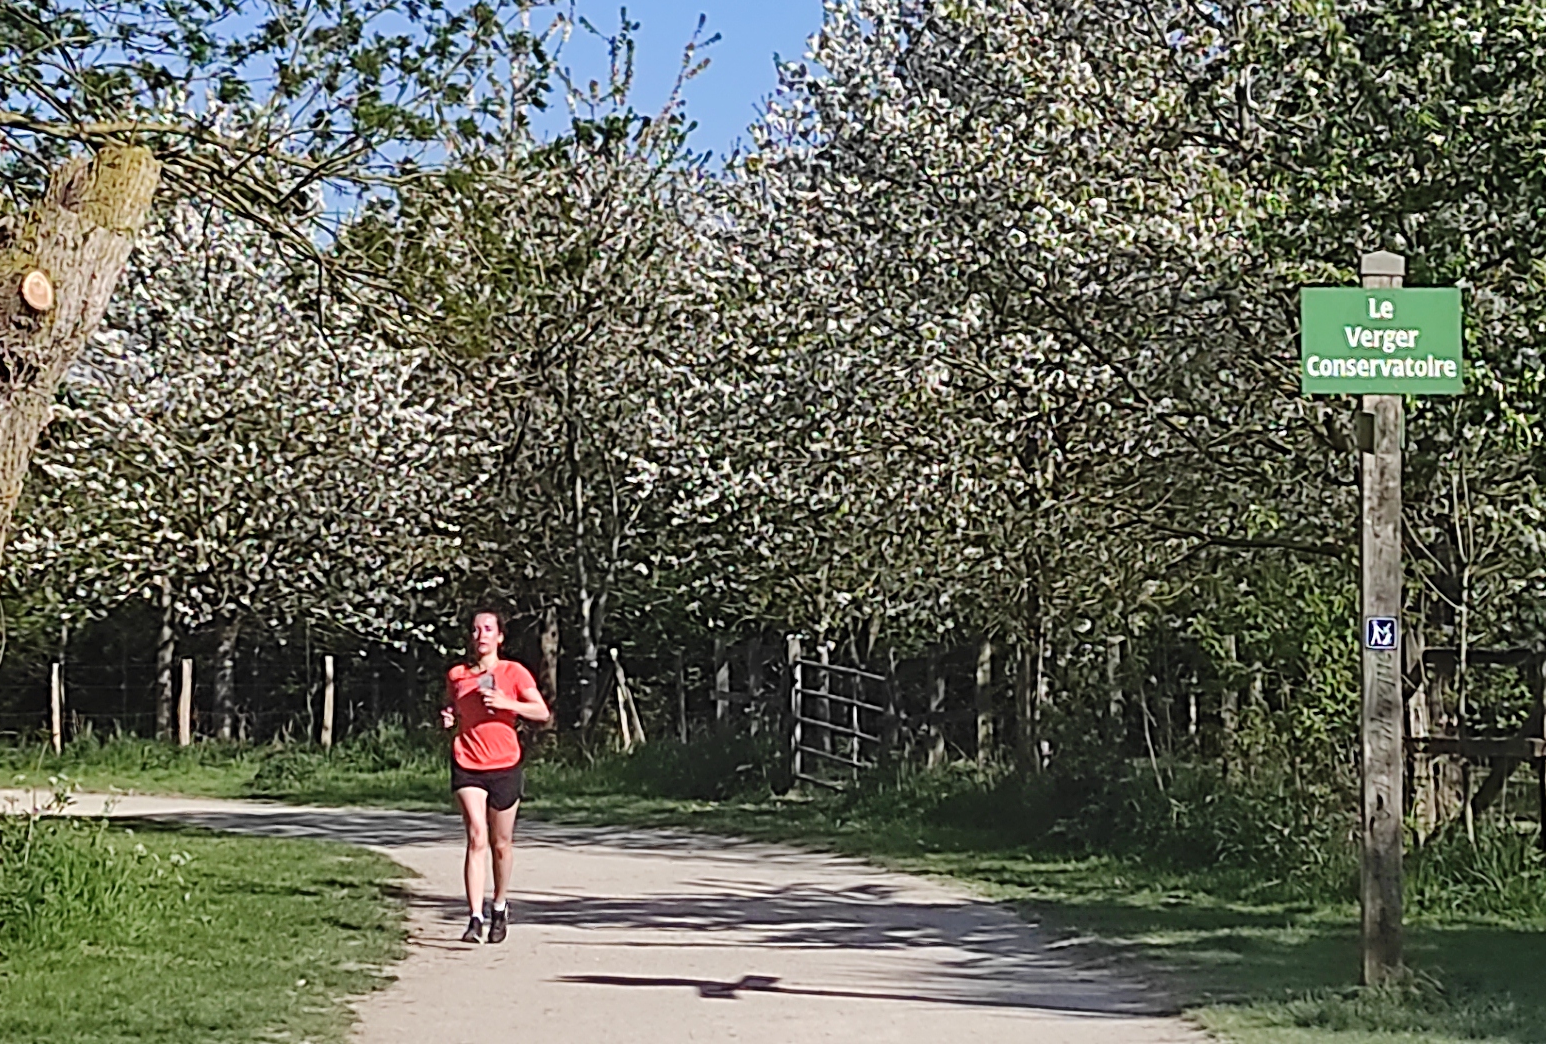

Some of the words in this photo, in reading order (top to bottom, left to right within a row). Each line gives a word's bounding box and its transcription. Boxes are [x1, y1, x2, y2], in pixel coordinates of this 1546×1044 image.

[1368, 298, 1393, 319] Le
[1345, 326, 1419, 353] Verger
[1306, 354, 1457, 378] Conservatoire
